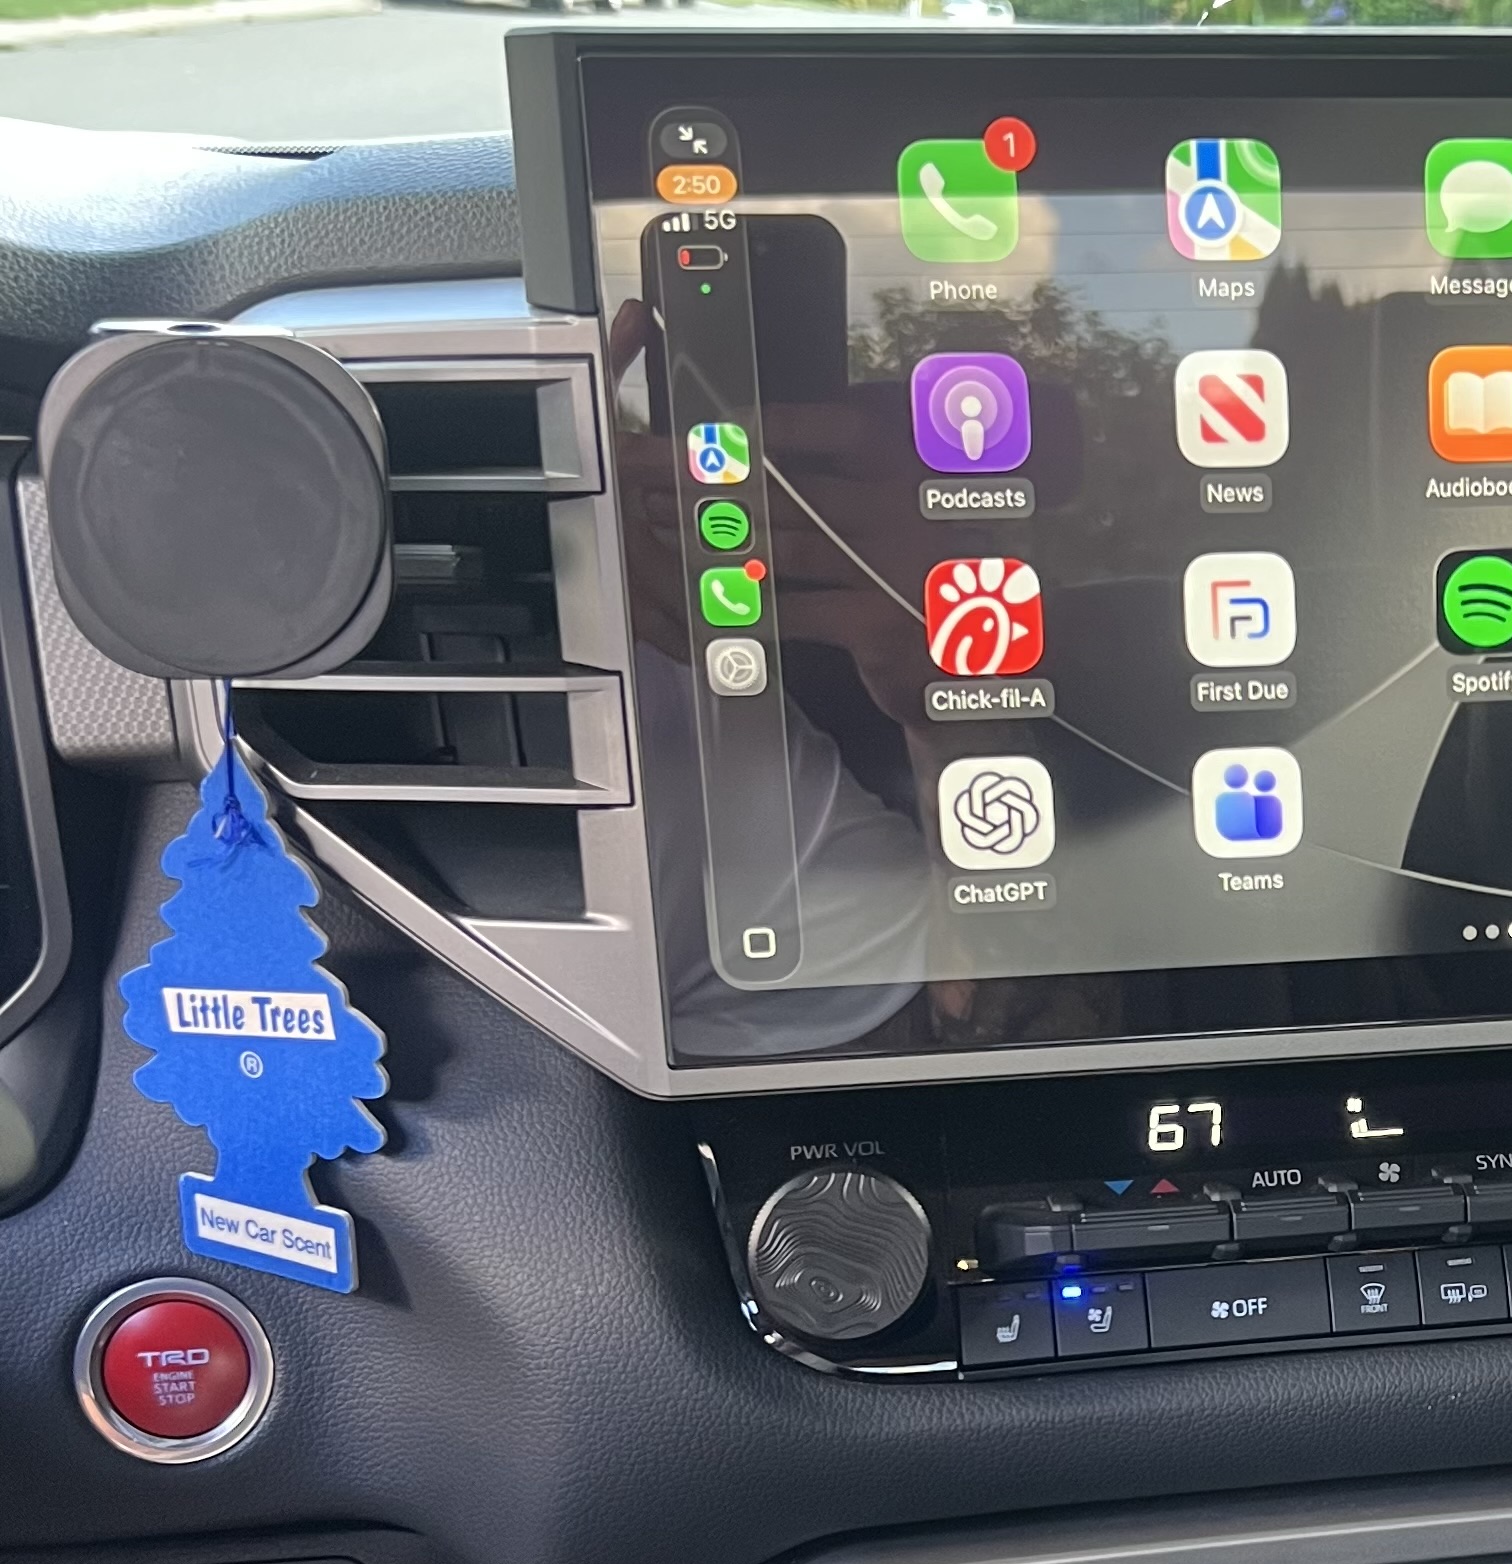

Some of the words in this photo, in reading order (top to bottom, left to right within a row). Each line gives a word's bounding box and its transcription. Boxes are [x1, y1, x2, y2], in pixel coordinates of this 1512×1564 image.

[1002, 134, 1015, 156] 1
[672, 175, 721, 195] 2:50
[704, 208, 736, 231] 5G
[929, 280, 998, 301] Phone
[1198, 276, 1256, 300] Maps
[925, 488, 1026, 510] Podcasts
[1207, 482, 1264, 505] News
[931, 687, 1046, 710] Chick-fil-A
[1198, 682, 1242, 702] First
[1248, 679, 1288, 702] Due
[1218, 870, 1284, 891] Teams
[954, 881, 1048, 905] ChatGPT
[176, 993, 246, 1032] Little
[252, 997, 326, 1035] Trees
[1148, 1101, 1222, 1152] 67
[789, 1144, 838, 1161] PWR
[843, 1141, 886, 1158] VOL
[1251, 1169, 1302, 1187] AUTO
[200, 1210, 239, 1235] New
[245, 1219, 277, 1243] Car
[283, 1230, 332, 1260] Scent
[1232, 1298, 1268, 1318] OFF
[1360, 1303, 1389, 1316] FRONT
[137, 1348, 210, 1367] TRD
[153, 1371, 192, 1382] ENGINE
[153, 1381, 195, 1394] START
[158, 1393, 195, 1407] STOP
